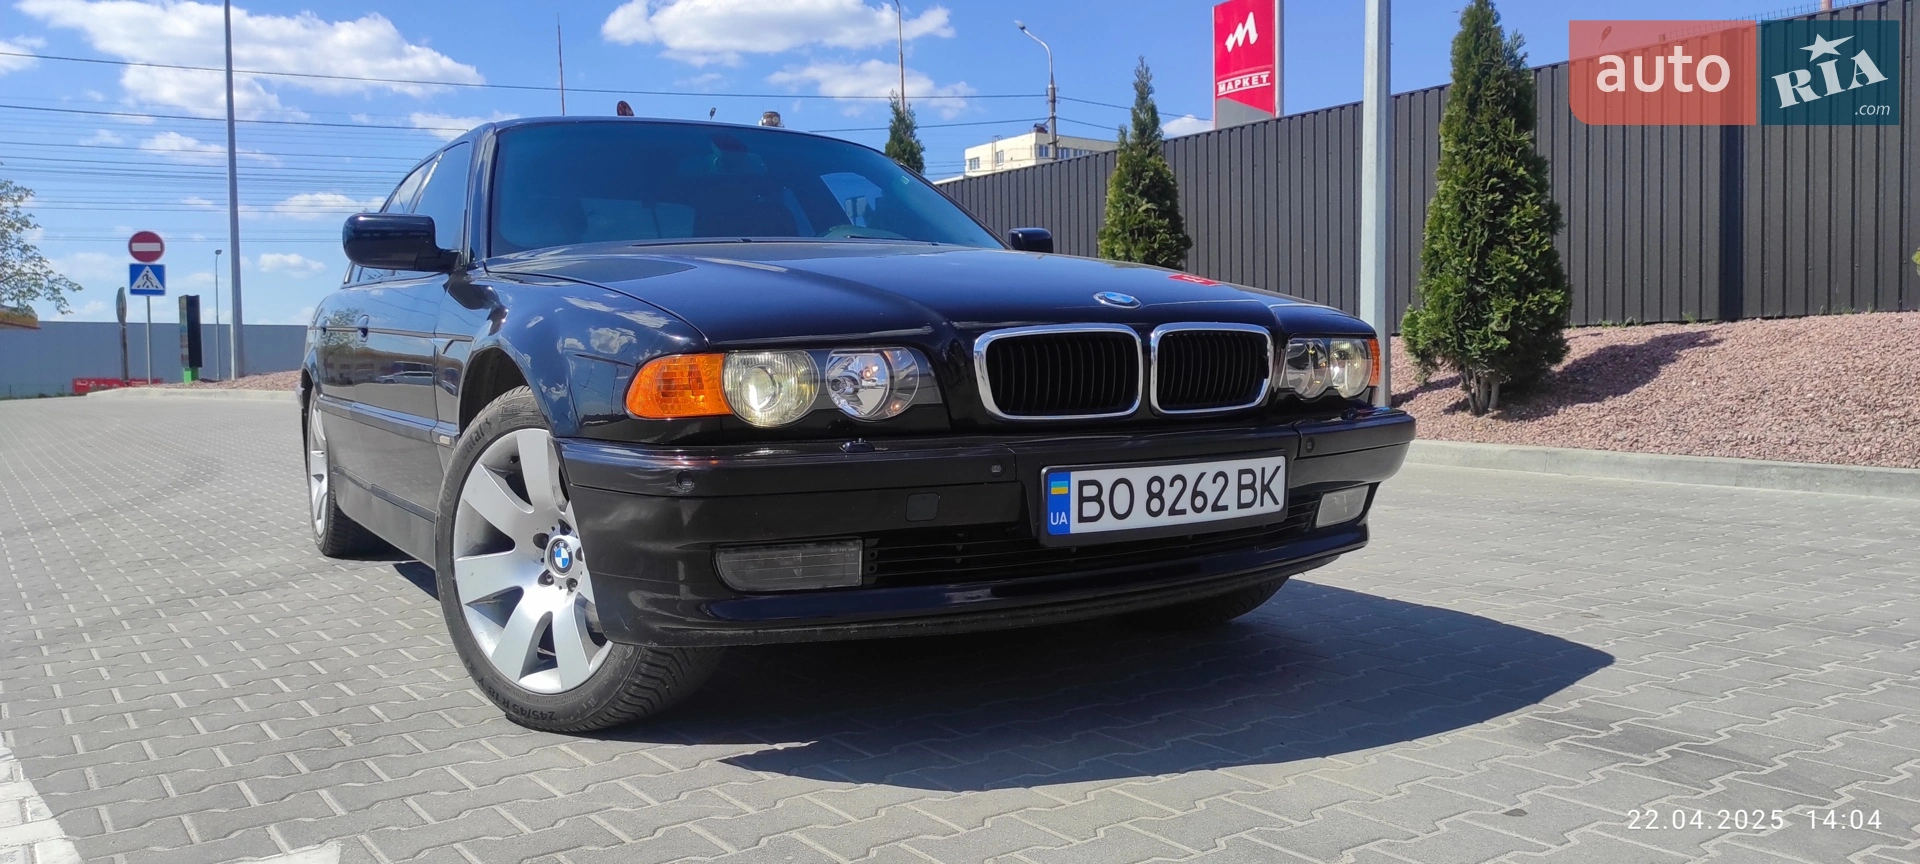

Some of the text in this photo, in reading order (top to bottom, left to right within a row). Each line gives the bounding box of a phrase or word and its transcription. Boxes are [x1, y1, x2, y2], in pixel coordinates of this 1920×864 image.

[1217, 73, 1269, 94] МАРКЕТ
[1077, 465, 1282, 524] BO 8262 BK
[1050, 511, 1068, 526] UA
[488, 686, 500, 702] 18
[502, 697, 510, 709] R
[510, 703, 557, 721] 245/45
